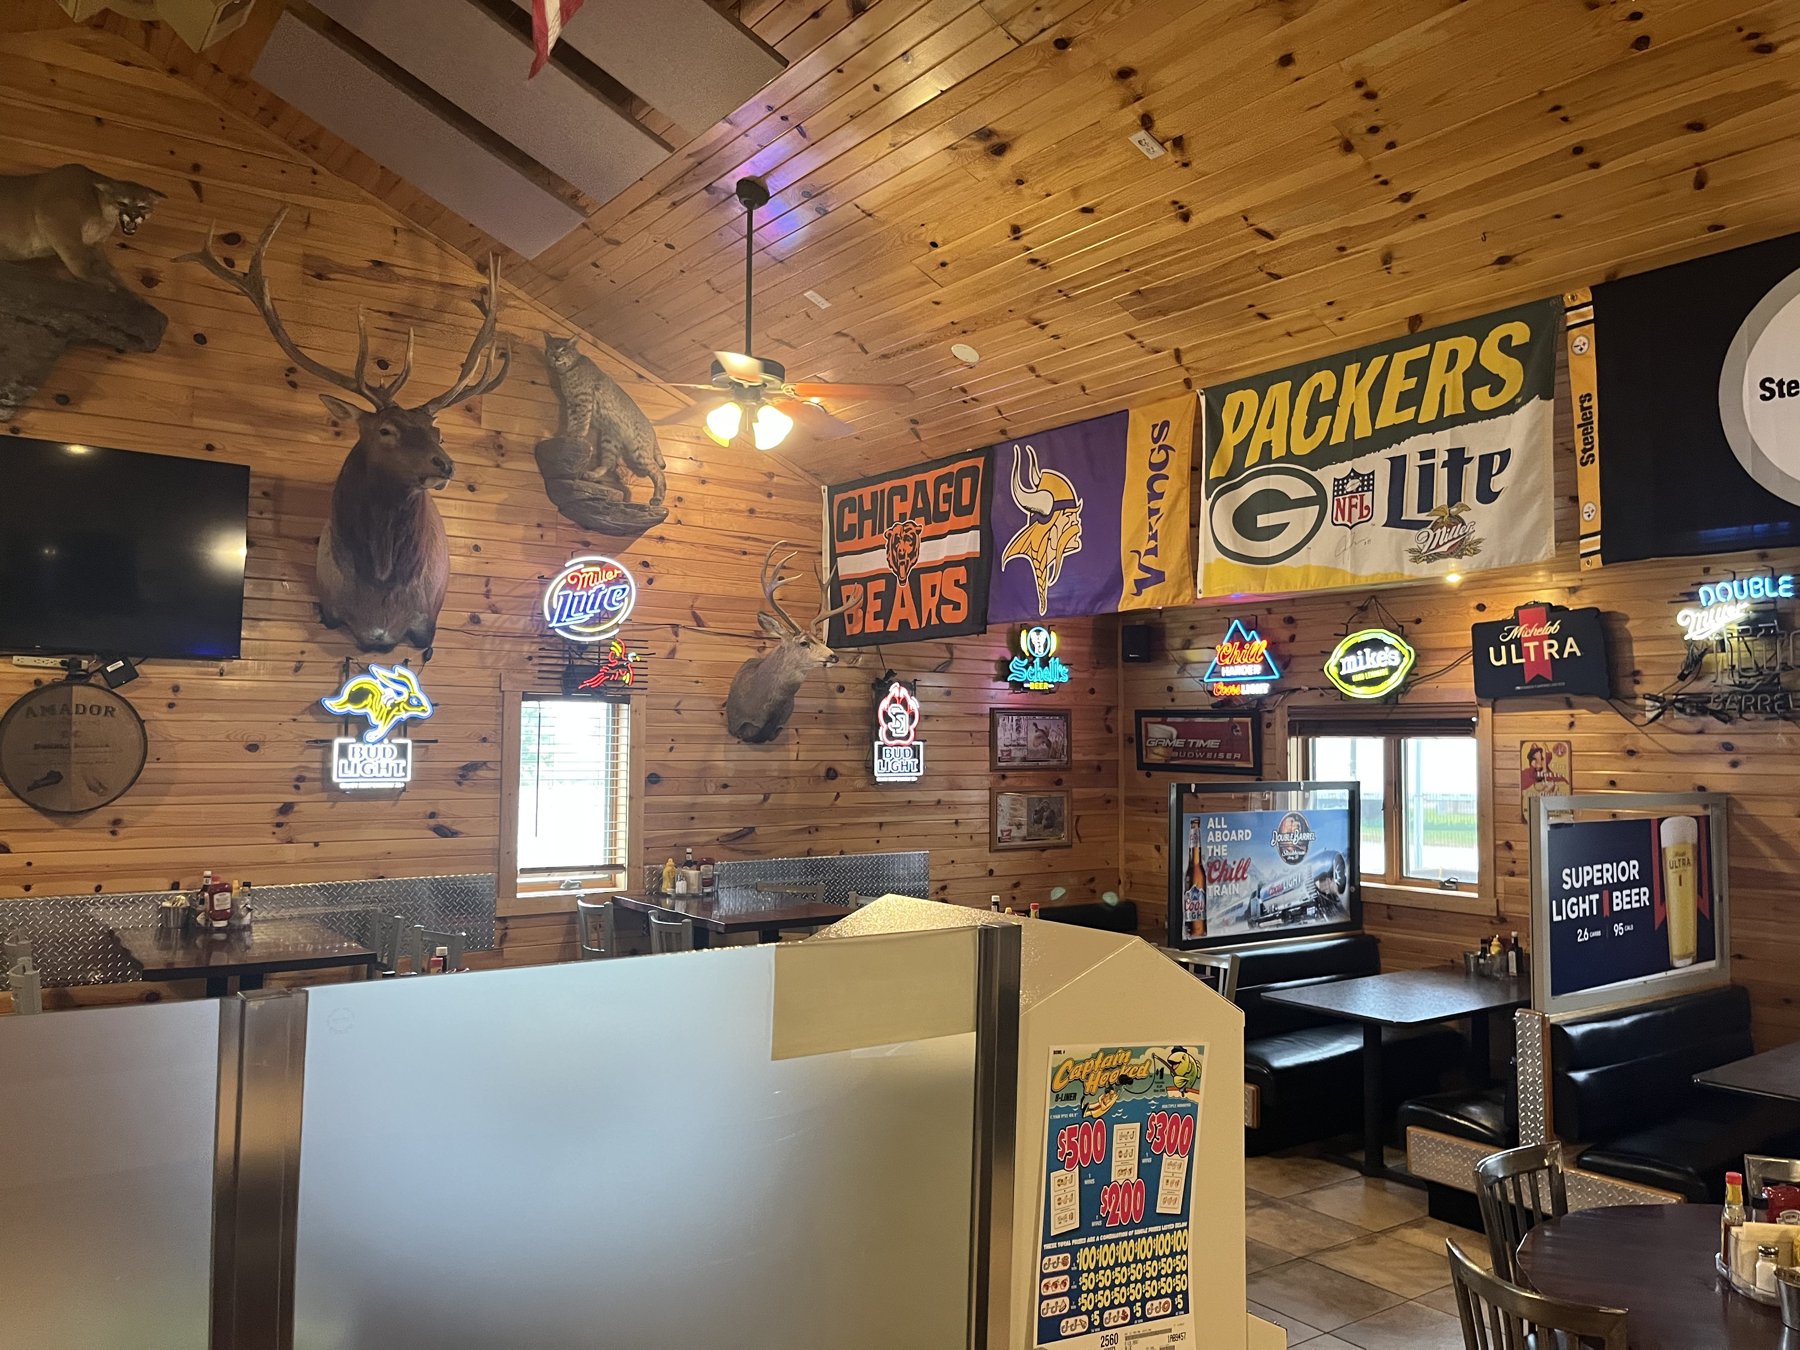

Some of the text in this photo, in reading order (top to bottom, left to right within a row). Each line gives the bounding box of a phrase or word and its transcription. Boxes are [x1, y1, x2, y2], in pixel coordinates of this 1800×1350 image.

[1210, 320, 1531, 480] PACKERS
[1577, 392, 1594, 467] Steelers
[1383, 447, 1512, 530] Lite
[836, 463, 981, 544] CHICAGO
[1335, 490, 1372, 525] NFL
[1415, 520, 1477, 556] Miller
[568, 568, 622, 590] Miller
[1698, 575, 1795, 607] DOUBLE
[549, 584, 630, 627] Lite
[840, 565, 968, 637] BEARS
[1499, 619, 1562, 642] Michelob
[1216, 640, 1268, 665] Chill
[1339, 647, 1402, 675] mike's
[1489, 637, 1582, 667] ULTRA
[1007, 656, 1069, 683] Schell's
[1221, 665, 1262, 676] HARDER
[1213, 682, 1270, 696] Coors LIGHT
[25, 703, 118, 718] AMADOR
[349, 744, 398, 761] BUD
[883, 747, 913, 759] BUD
[1146, 738, 1221, 749] GAME TIME
[1171, 752, 1241, 760] BUDWEISER
[338, 759, 406, 777] LIGHT
[878, 759, 918, 773] LIGHT
[1207, 817, 1228, 830] ALL
[1207, 829, 1252, 843] ABOARD
[1207, 844, 1228, 857] THE
[1669, 857, 1692, 870] ULTRA
[1206, 856, 1251, 884] Chill
[1562, 860, 1640, 890] SUPERIOR
[1206, 884, 1240, 897] TRAIN
[1552, 887, 1650, 922] LIGHT BEER
[1577, 928, 1589, 942] 2.6
[1613, 923, 1624, 937] 95
[1051, 1048, 1132, 1093] Captain
[1084, 1058, 1152, 1095] Hooked
[1057, 1119, 1107, 1171] $500
[1146, 1111, 1194, 1158] $300
[1100, 1178, 1146, 1227] $200
[1077, 1229, 1188, 1270] $100 $100 $100 $100 $100 $100
[1079, 1272, 1095, 1291] $50
[1096, 1269, 1111, 1288] $50
[1112, 1266, 1127, 1284] $50
[1128, 1263, 1142, 1281] $50
[1143, 1260, 1158, 1278] $50
[1158, 1257, 1172, 1275] $50
[1173, 1254, 1187, 1272] $50
[1078, 1292, 1094, 1311] $50
[1095, 1289, 1110, 1308] $50
[1111, 1286, 1126, 1305] $50
[1127, 1283, 1142, 1301] $50
[1143, 1280, 1158, 1298] $50
[1158, 1277, 1172, 1295] $50
[1173, 1274, 1187, 1292] $50
[1091, 1294, 1183, 1326] $5 $5 $5
[1101, 1333, 1119, 1348] 2560
